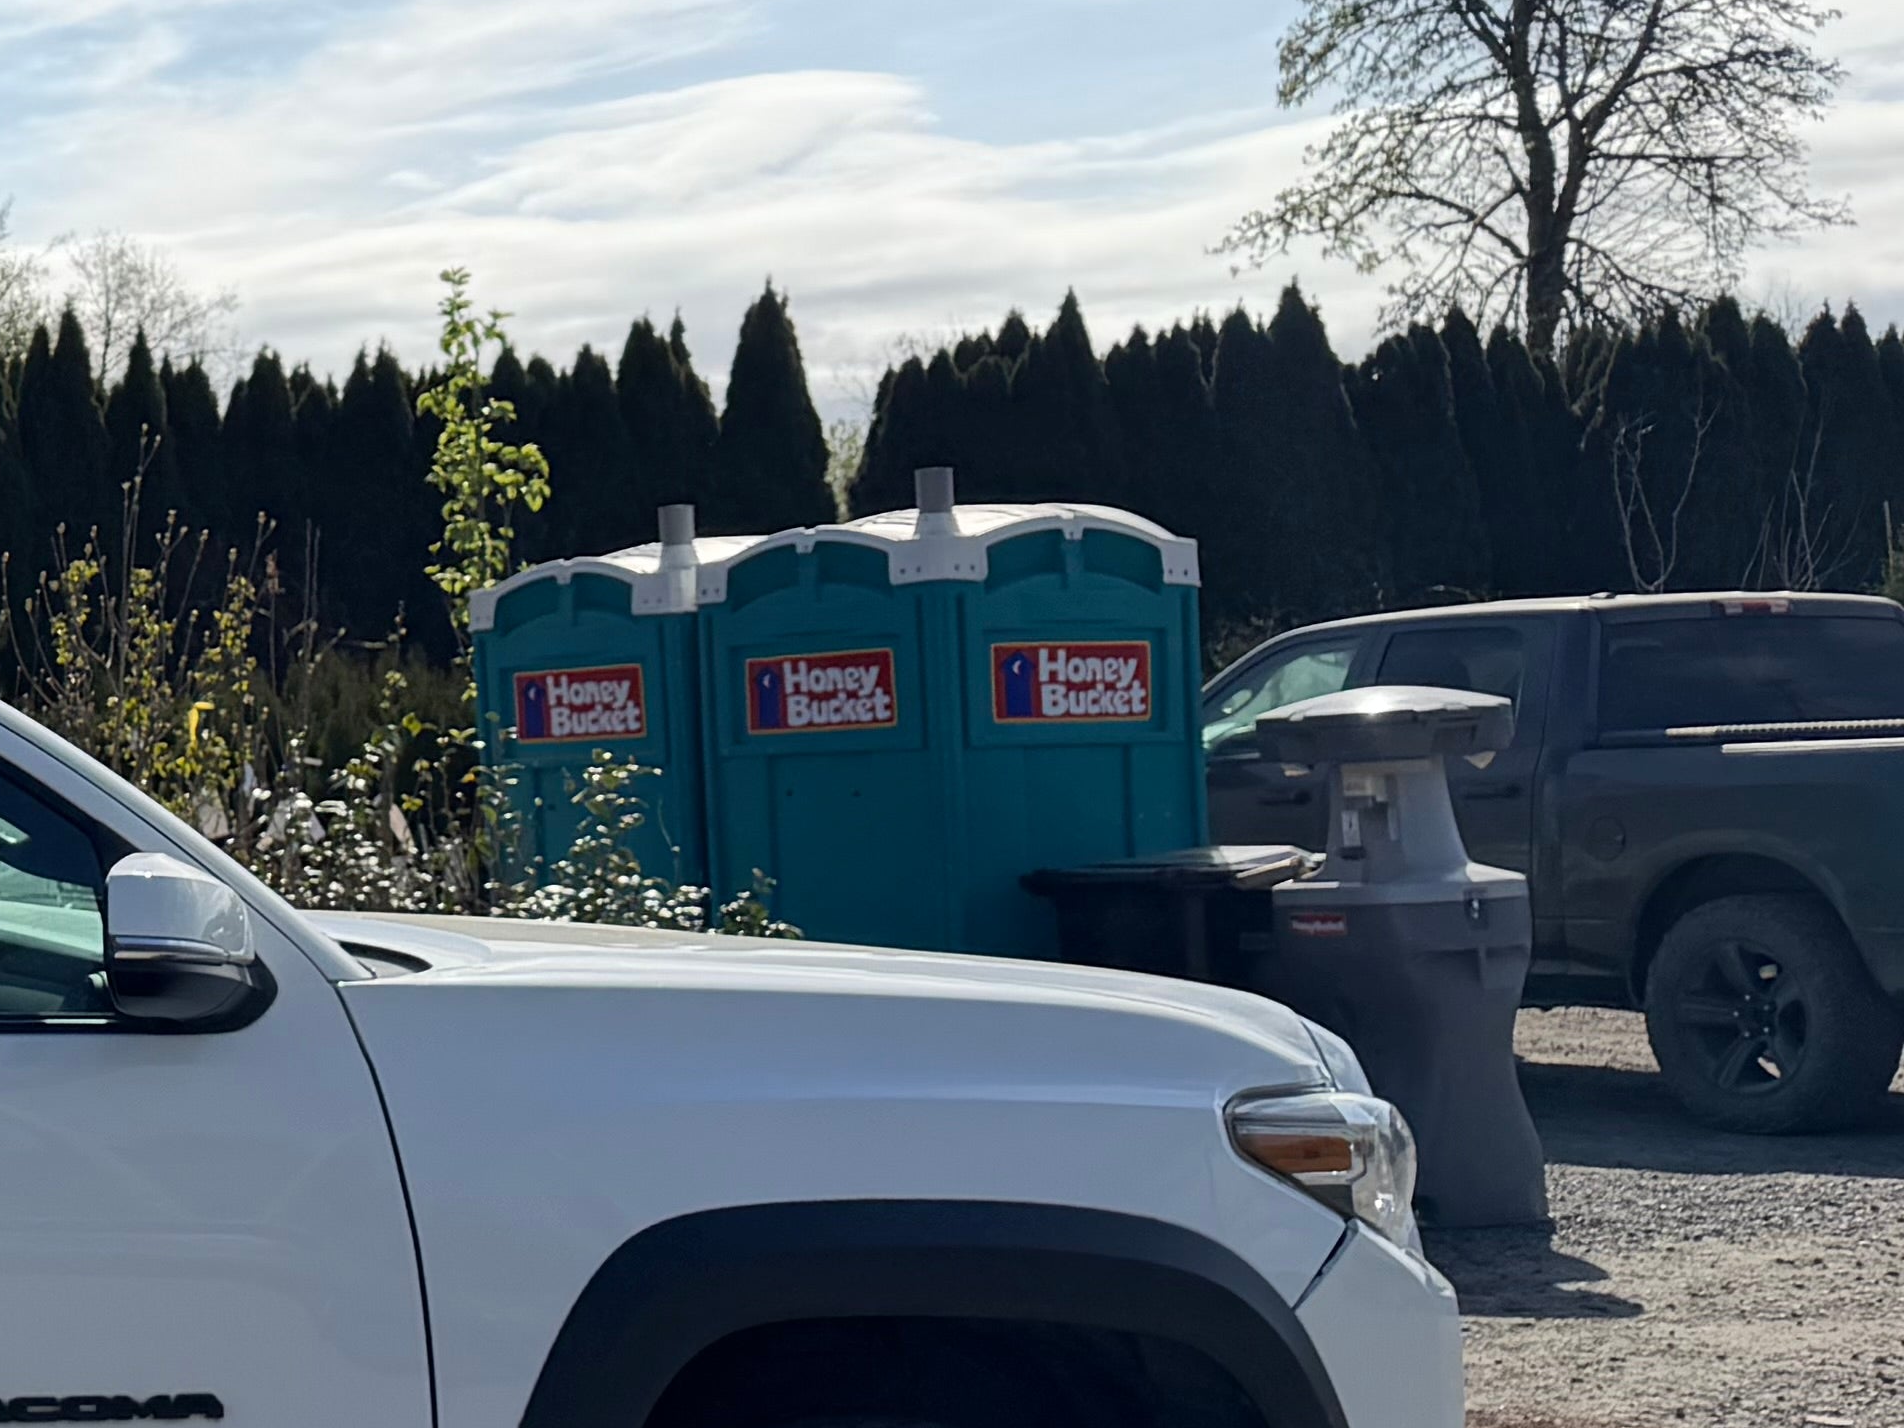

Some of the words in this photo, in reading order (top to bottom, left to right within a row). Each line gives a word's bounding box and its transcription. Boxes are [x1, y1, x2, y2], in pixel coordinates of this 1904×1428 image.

[782, 660, 880, 696] Honey
[1038, 648, 1138, 688] Honey
[545, 674, 631, 708] Honey
[786, 687, 892, 727] Bucket
[1040, 679, 1147, 717] Bucket
[550, 700, 642, 737] Bucket
